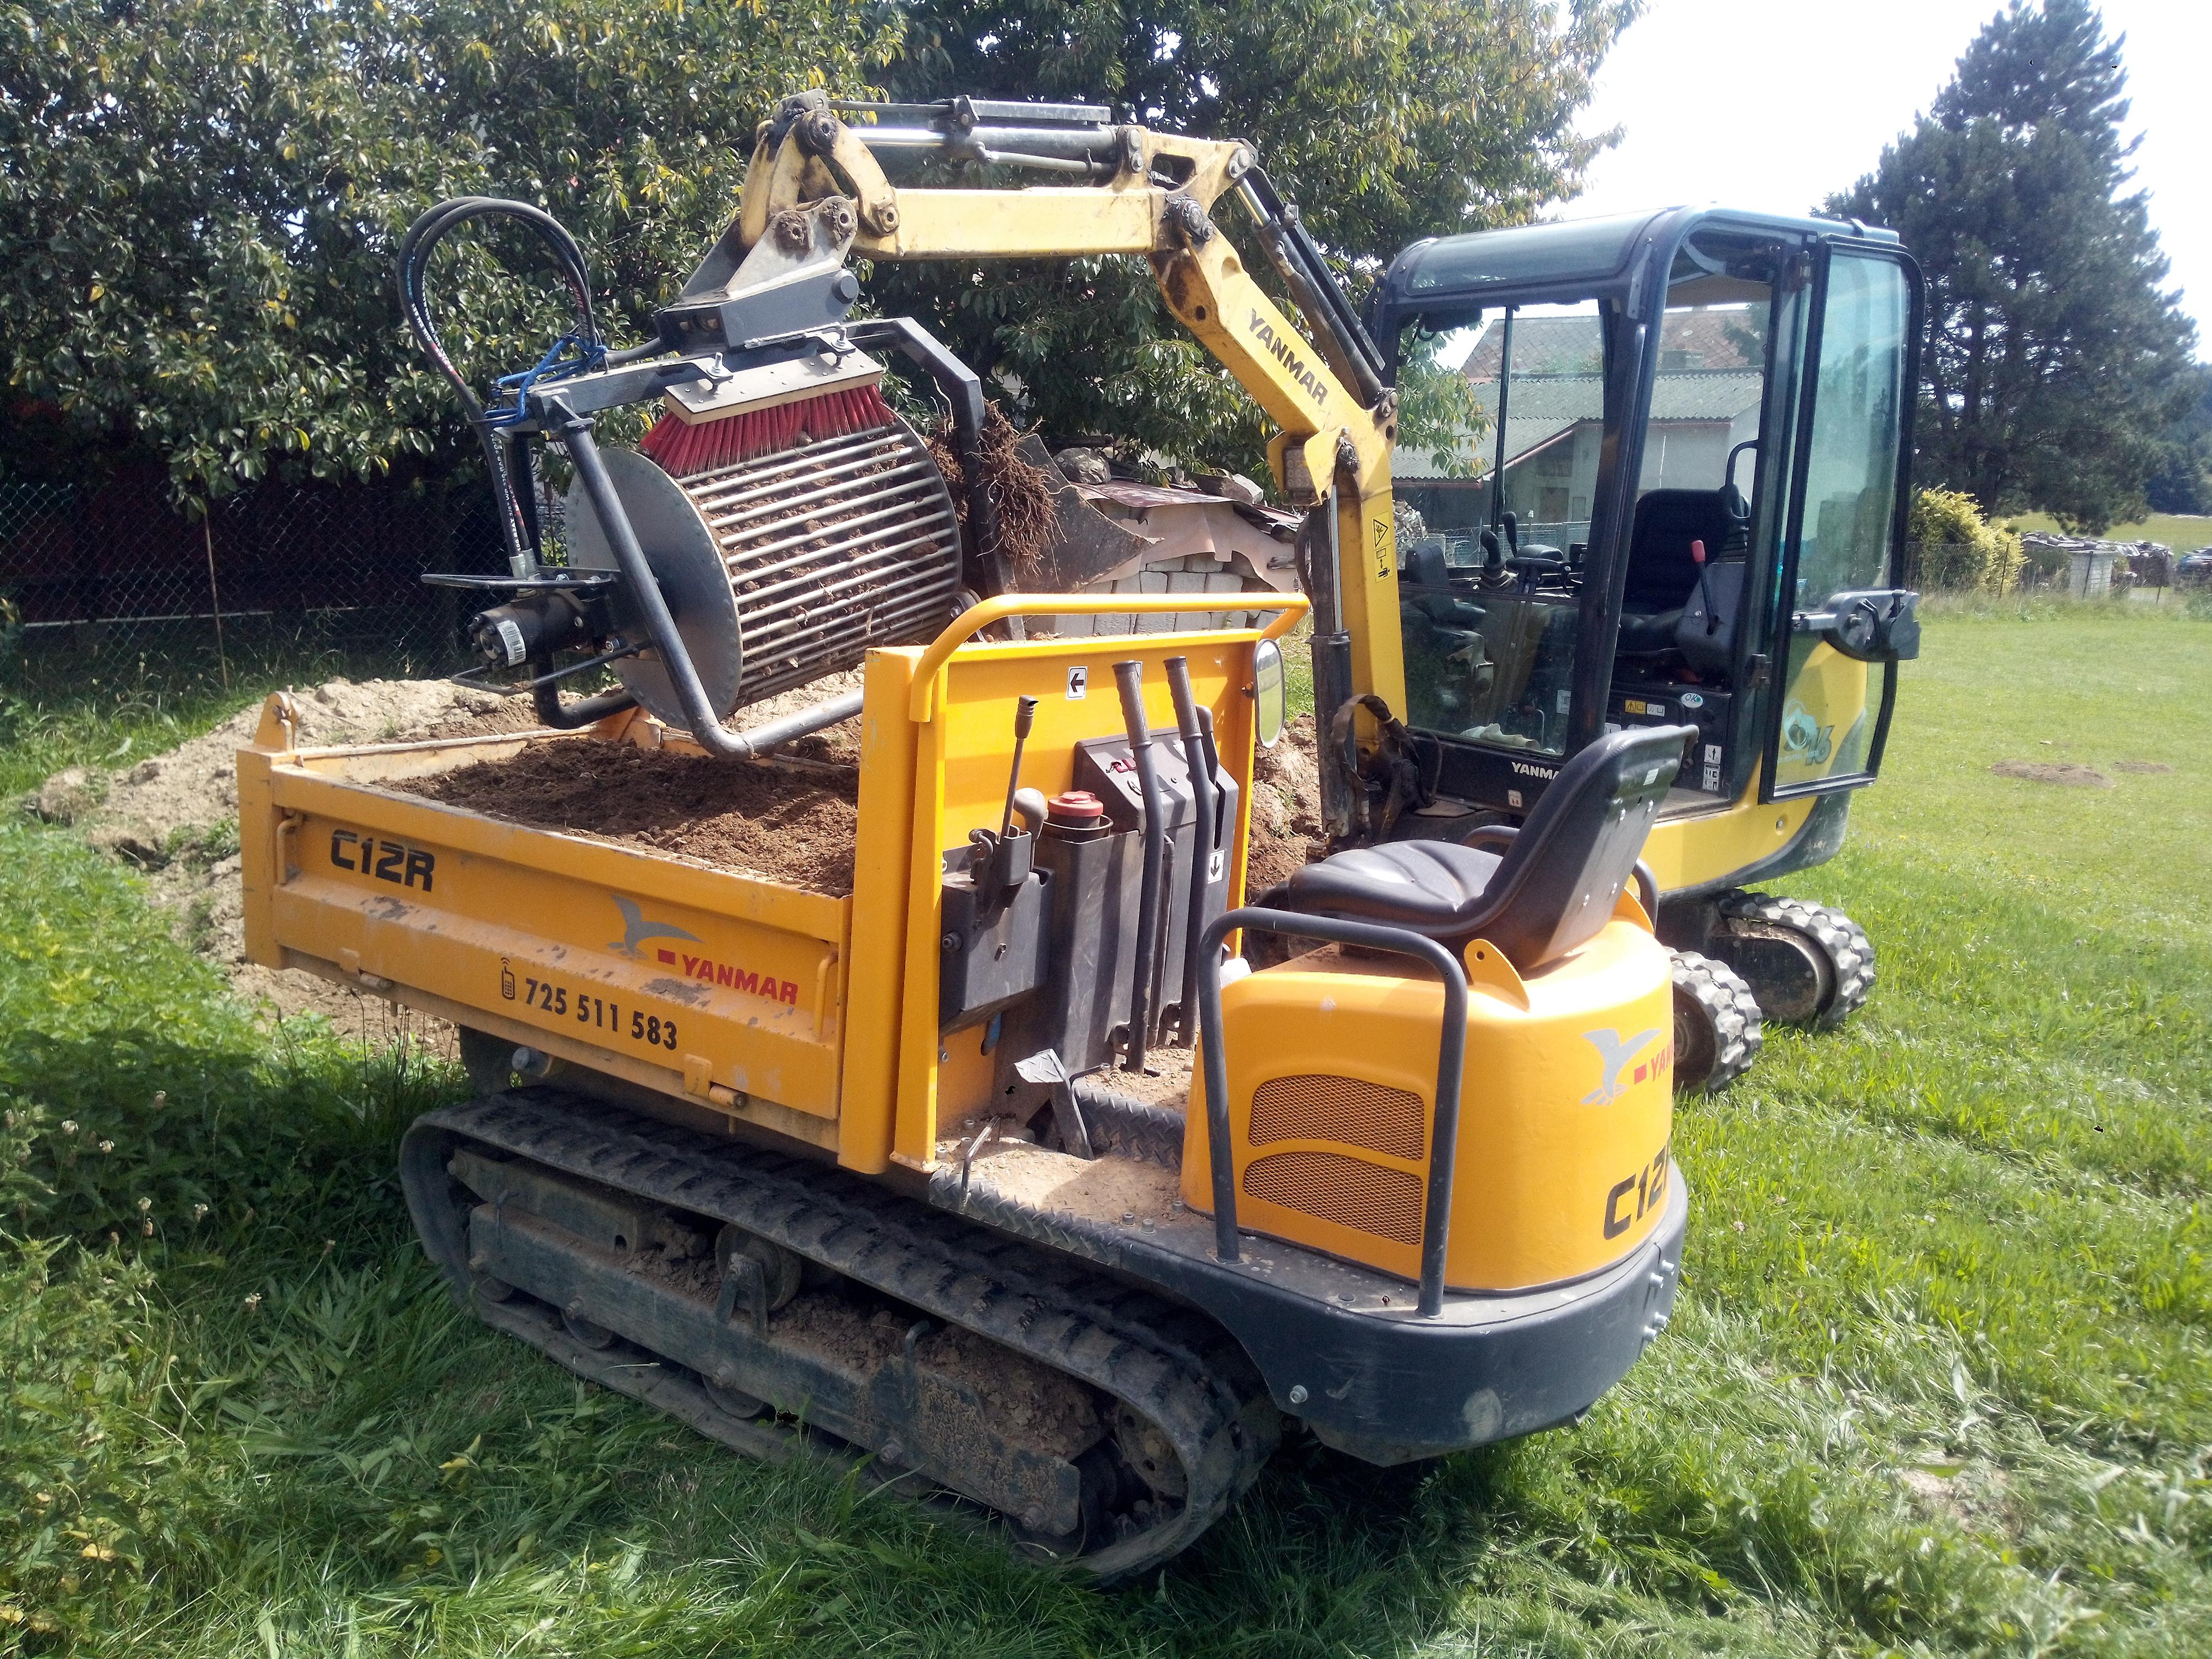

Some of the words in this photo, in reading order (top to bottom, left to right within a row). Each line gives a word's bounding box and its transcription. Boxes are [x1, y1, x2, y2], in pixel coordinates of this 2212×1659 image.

[1249, 307, 1328, 406] YANMAR
[1684, 693, 1699, 703] OK
[331, 829, 435, 893] C12R
[682, 954, 798, 1005] YANMAR
[526, 977, 566, 1015] 725
[577, 993, 618, 1032] 511
[632, 1010, 677, 1050] 583
